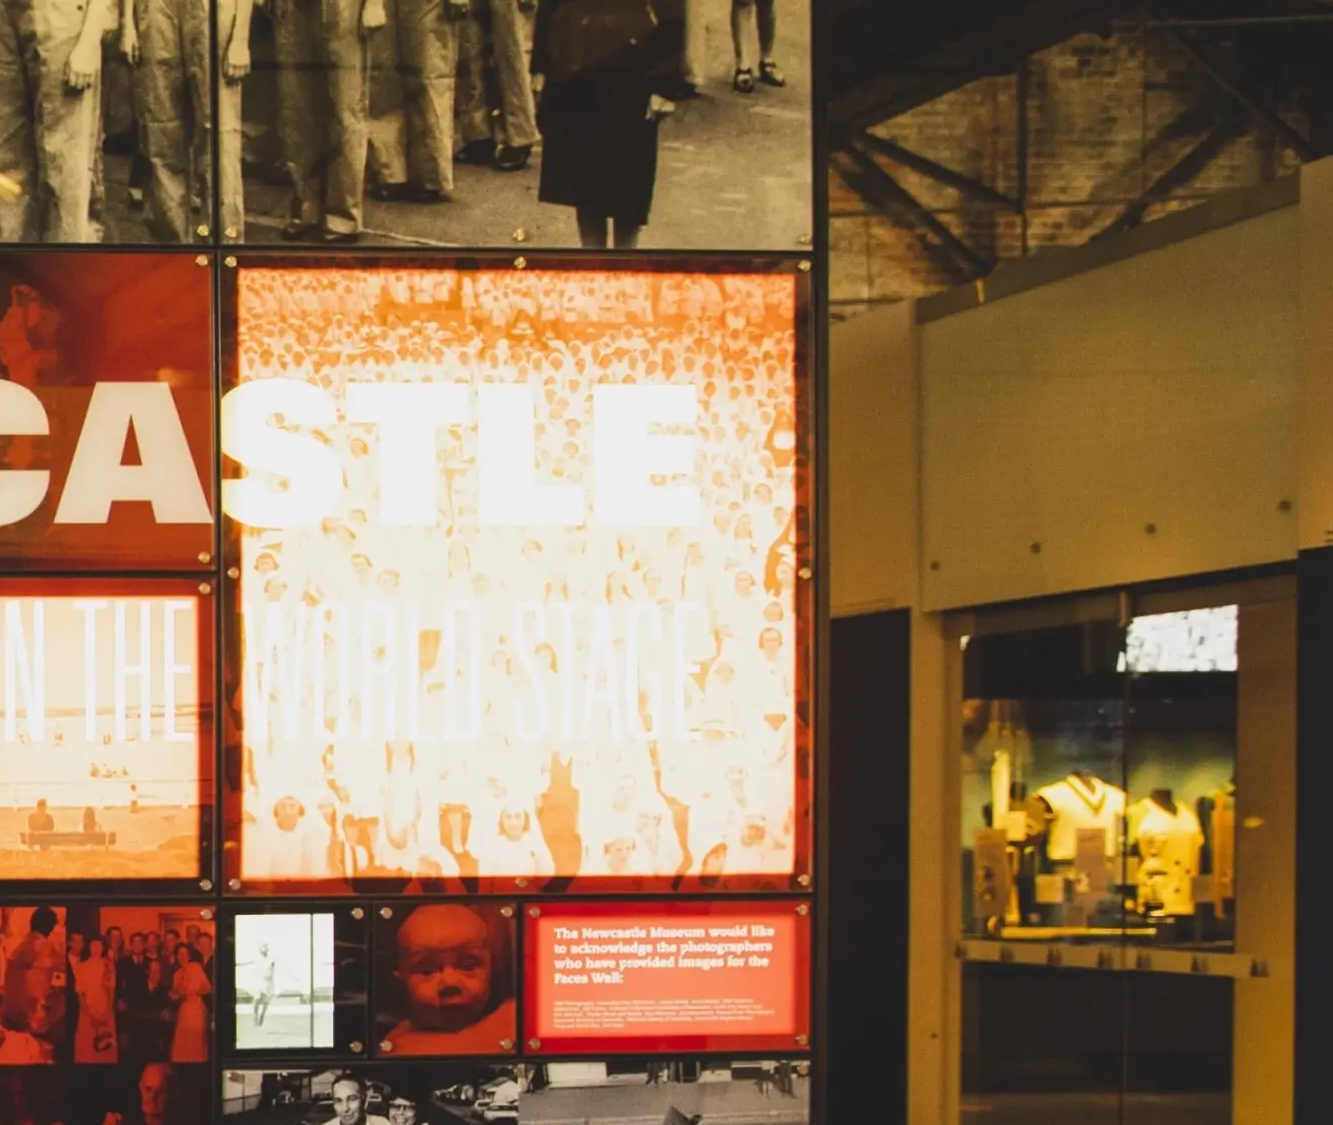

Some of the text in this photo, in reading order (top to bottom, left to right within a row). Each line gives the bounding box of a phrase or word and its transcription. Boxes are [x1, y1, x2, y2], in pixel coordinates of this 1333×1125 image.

[73, 599, 195, 744] THE
[245, 599, 483, 745] WORLD
[510, 599, 703, 745] STAGE
[554, 924, 775, 940] The Newcastle Museum would like
[554, 940, 774, 957] to acknowledge the photographers
[554, 954, 770, 971] who have provided images for the
[553, 972, 624, 985] Faces Wall:
